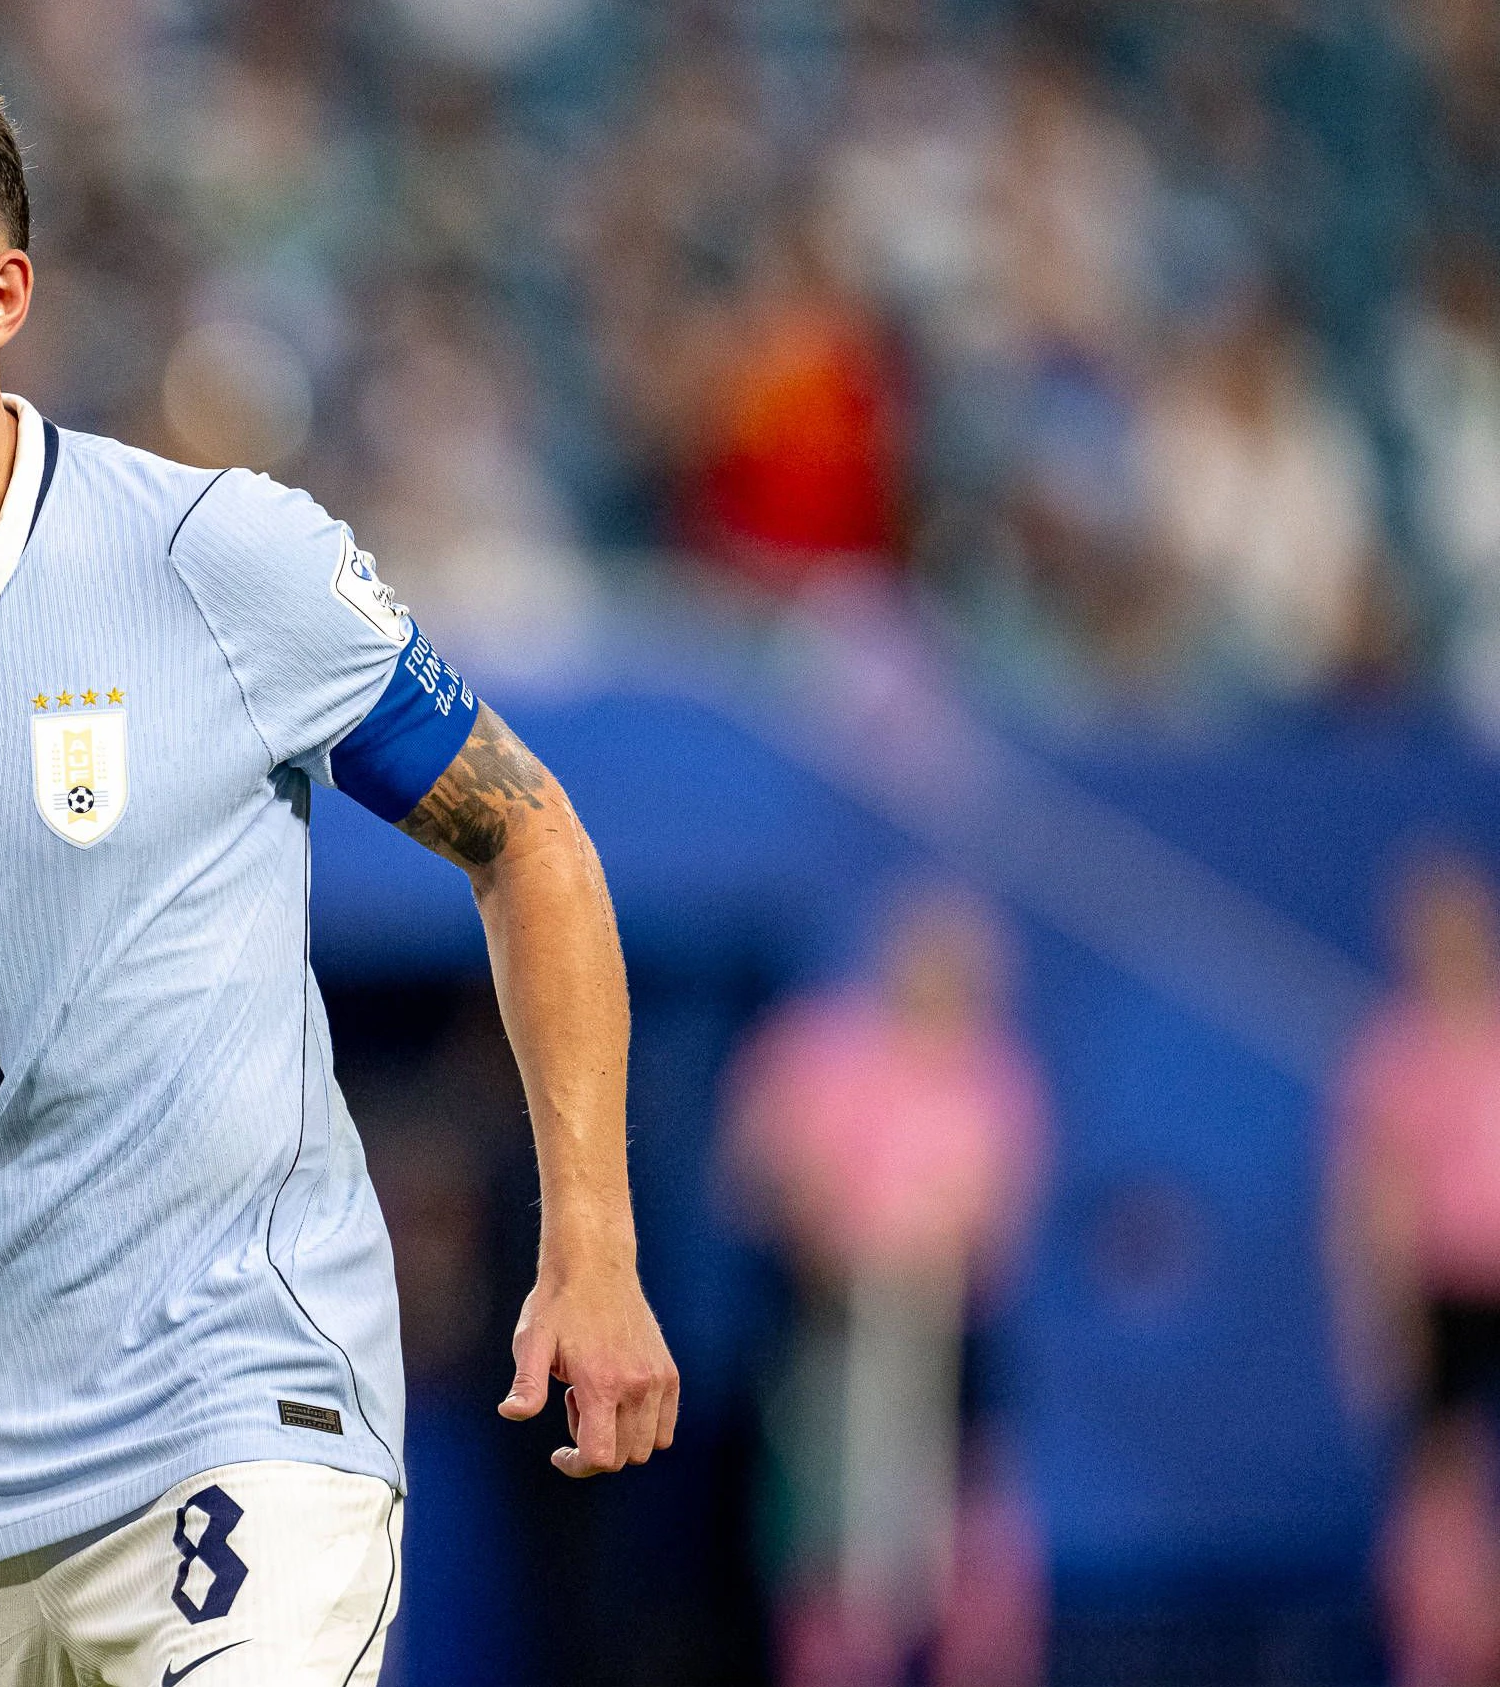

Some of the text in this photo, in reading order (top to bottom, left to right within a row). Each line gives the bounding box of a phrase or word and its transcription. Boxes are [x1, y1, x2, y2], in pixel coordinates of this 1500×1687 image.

[404, 632, 432, 676] FOO
[434, 683, 457, 717] the
[68, 739, 90, 784] AUF
[171, 1485, 249, 1625] 8
